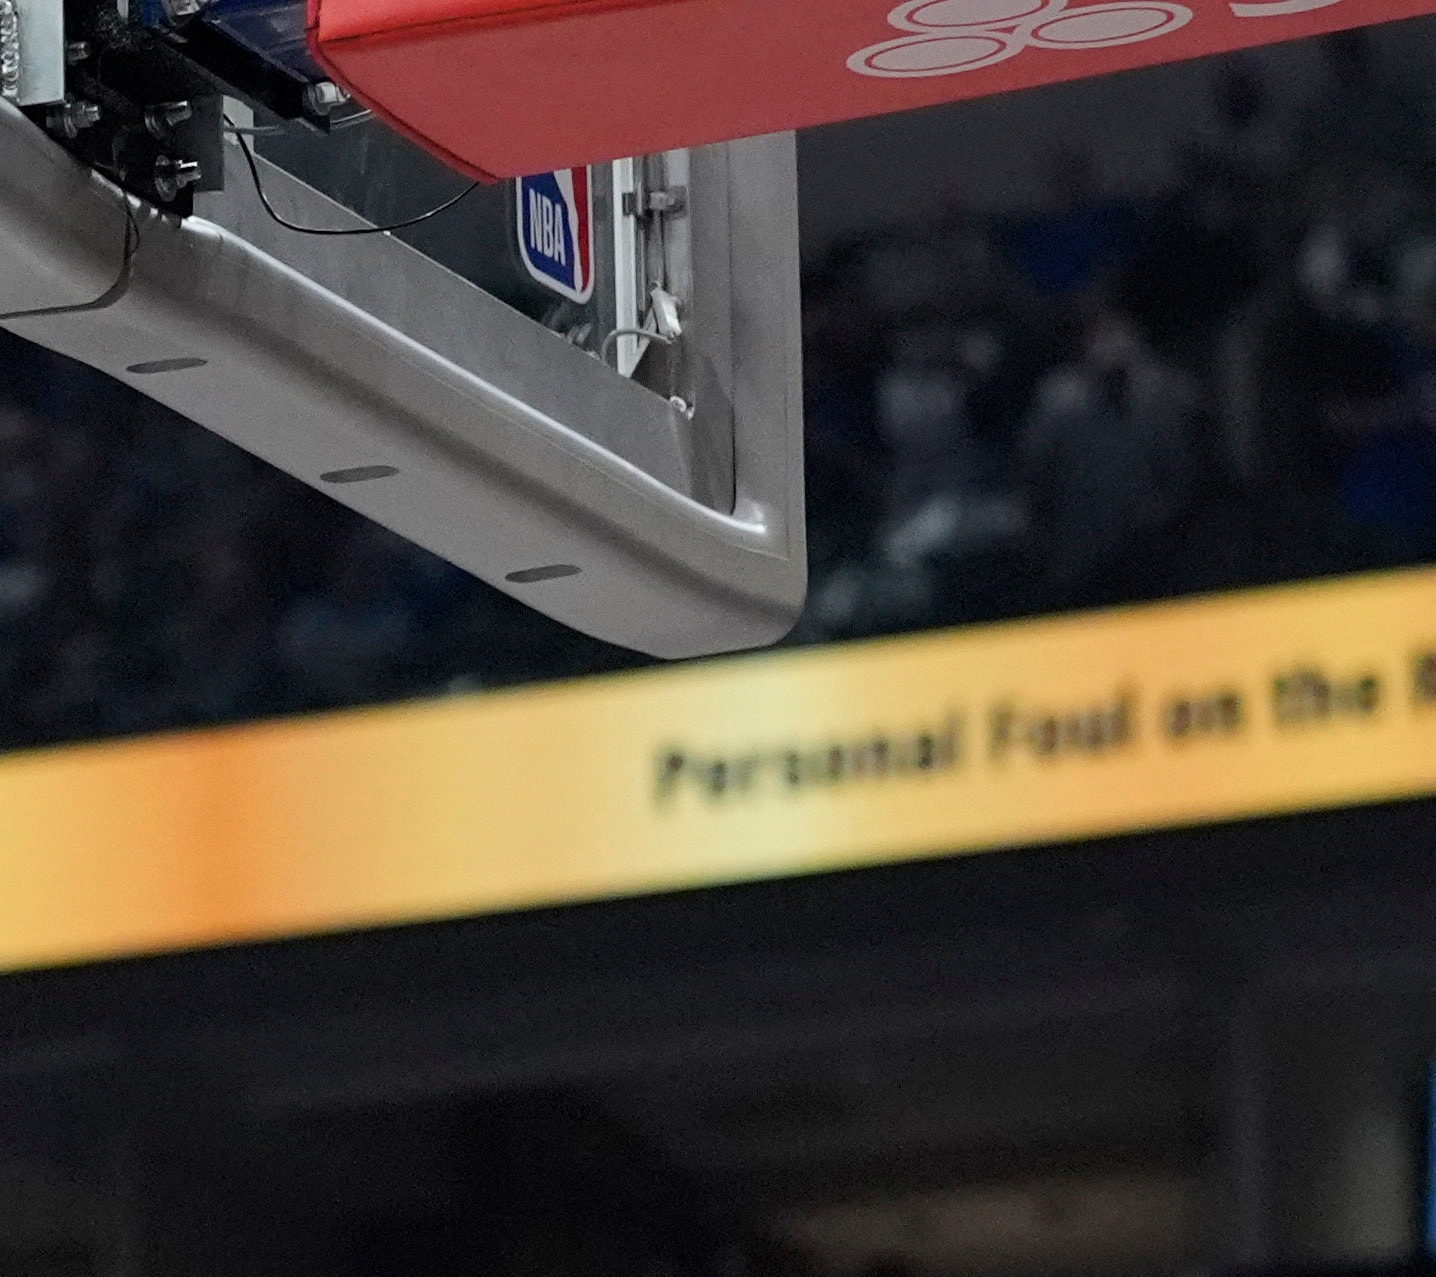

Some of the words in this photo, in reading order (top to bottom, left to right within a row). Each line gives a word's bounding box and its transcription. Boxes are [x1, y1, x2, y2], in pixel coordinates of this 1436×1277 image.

[529, 188, 566, 266] NBA
[658, 710, 964, 797] Personal
[988, 686, 1138, 760] Foul
[1164, 690, 1243, 739] on
[1272, 668, 1381, 727] the
